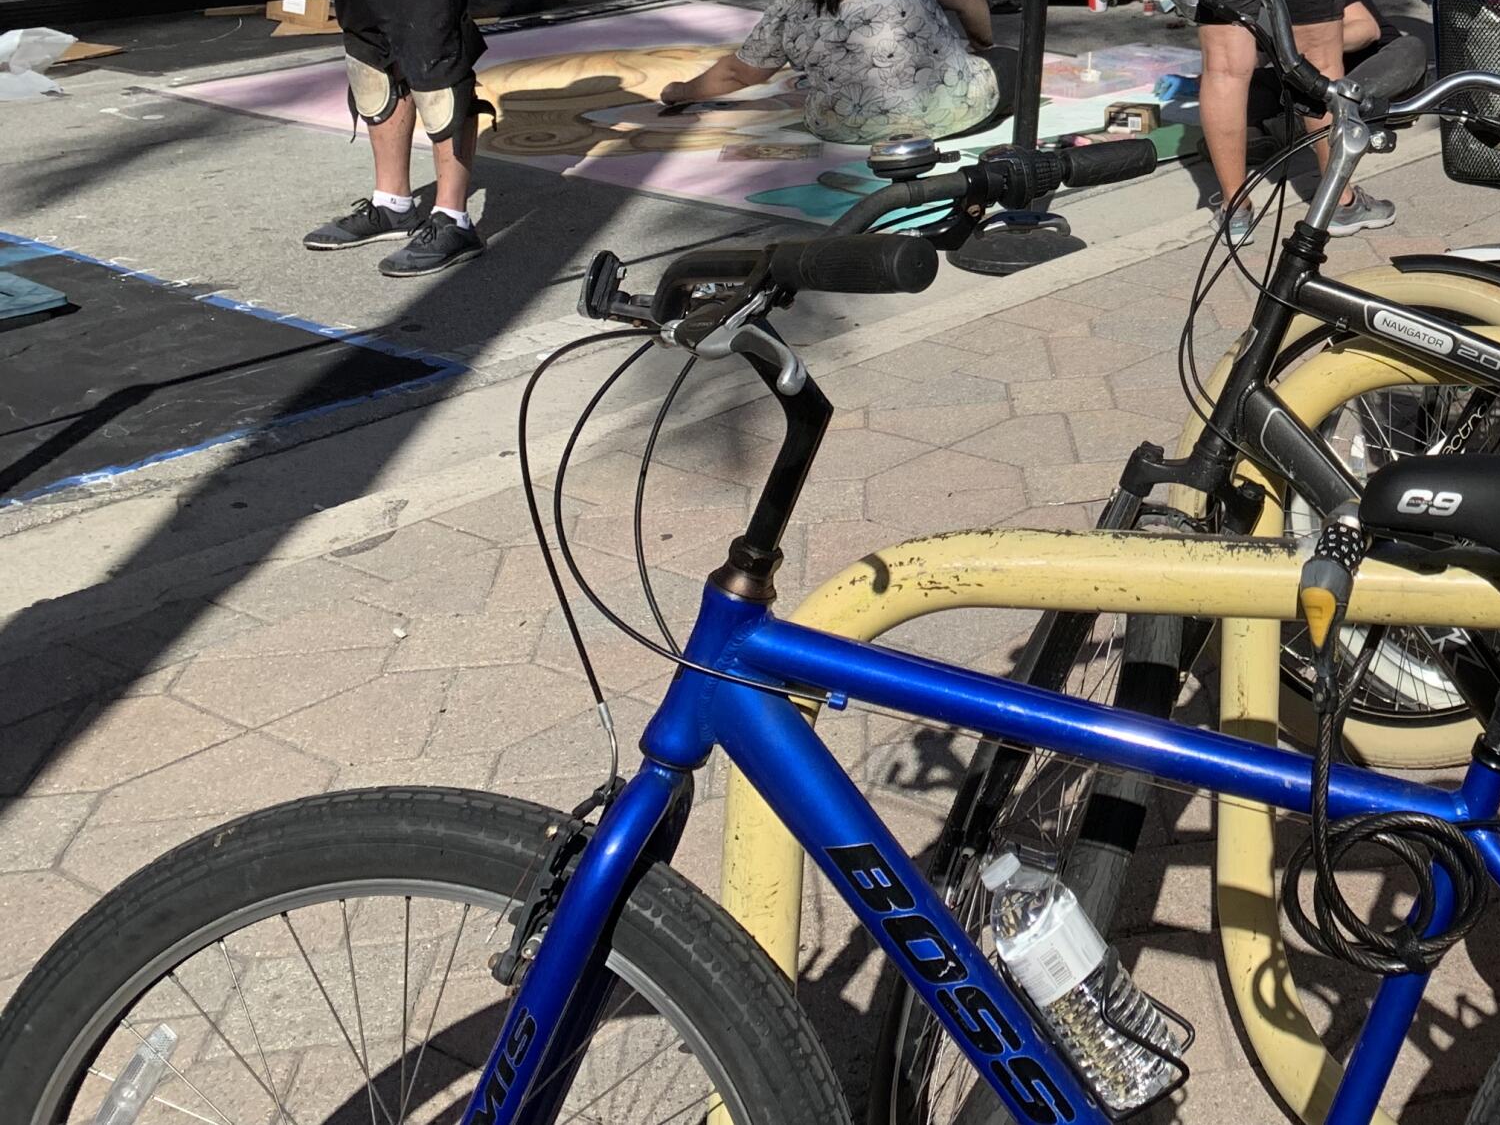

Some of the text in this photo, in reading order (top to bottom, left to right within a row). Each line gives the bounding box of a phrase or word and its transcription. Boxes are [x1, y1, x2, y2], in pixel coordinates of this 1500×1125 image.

[1381, 317, 1445, 349] NAVIGATOR
[1397, 488, 1463, 516] C9
[822, 843, 1077, 1125] BOSS
